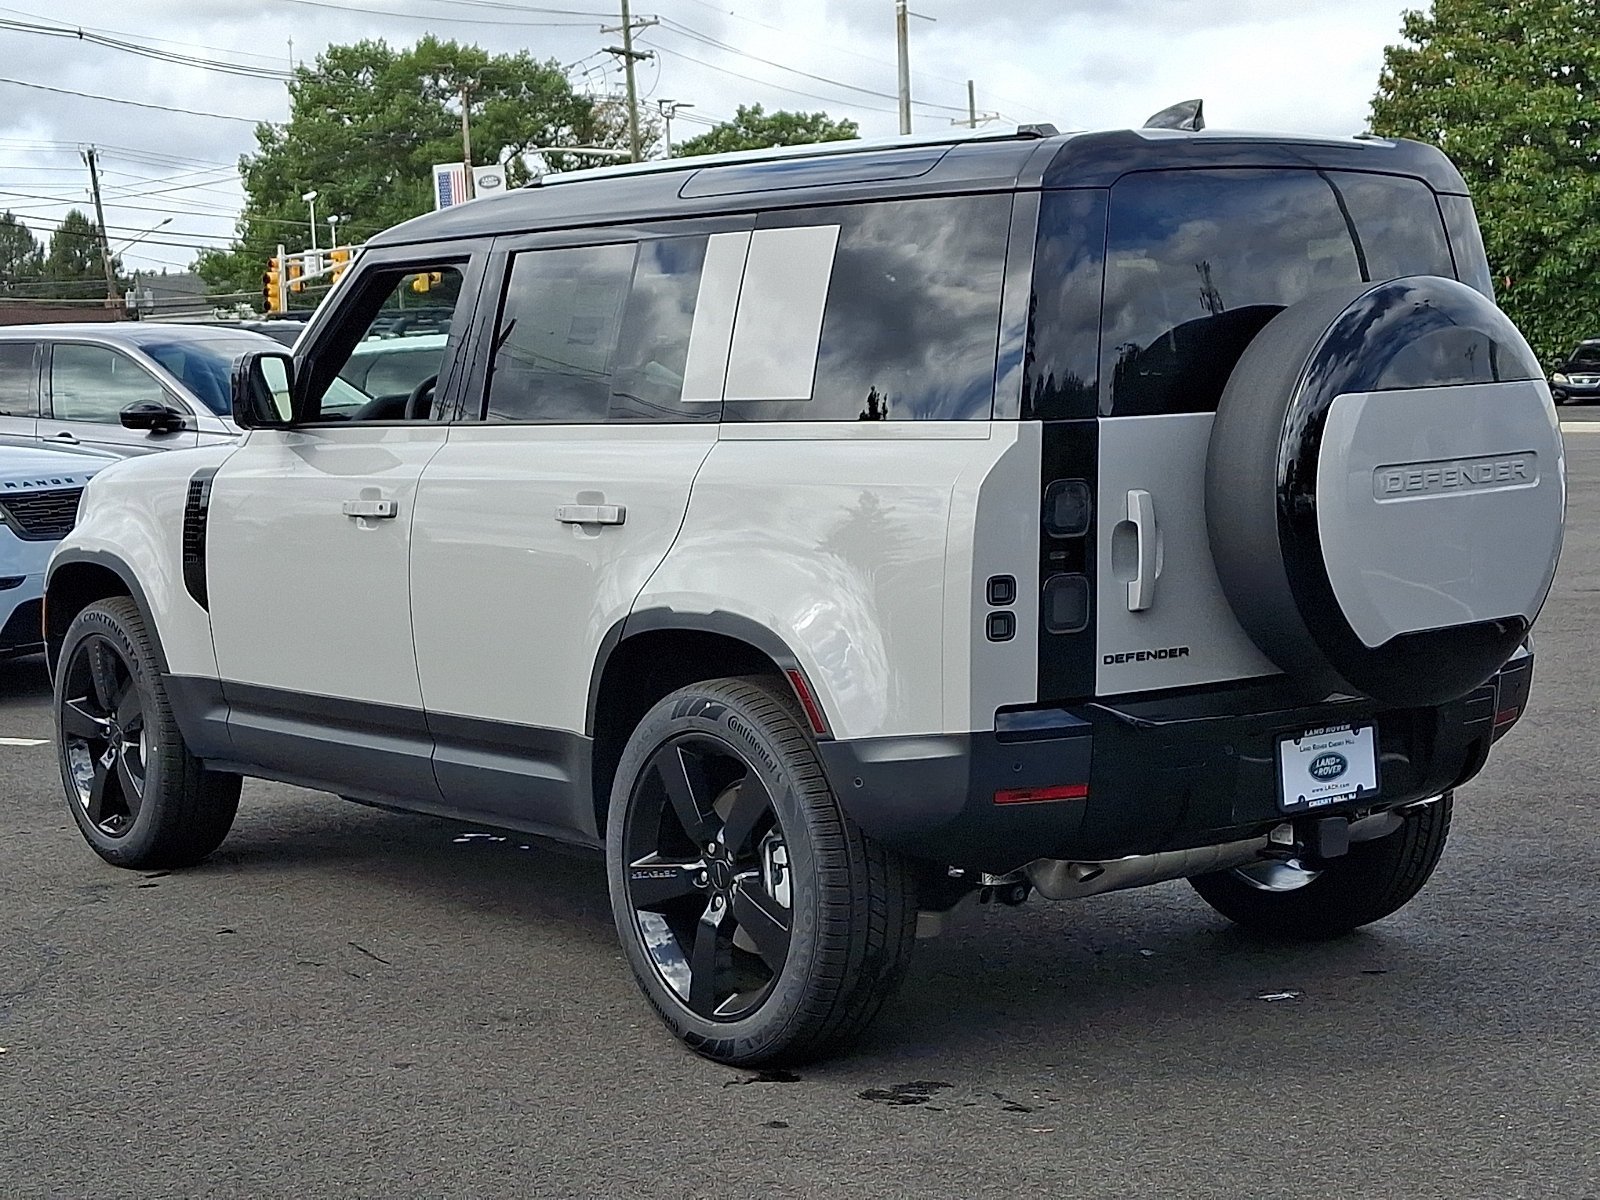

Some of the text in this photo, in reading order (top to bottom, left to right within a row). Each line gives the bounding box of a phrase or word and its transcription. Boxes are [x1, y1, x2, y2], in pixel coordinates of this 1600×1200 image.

[4, 477, 74, 488] RANGE
[1384, 459, 1527, 493] DEFENDER
[1103, 646, 1190, 665] DEFENDER
[1304, 723, 1351, 737] LAND ROVER
[727, 715, 778, 774] Continental
[1316, 757, 1336, 768] LAND
[1318, 764, 1342, 776] ROVER
